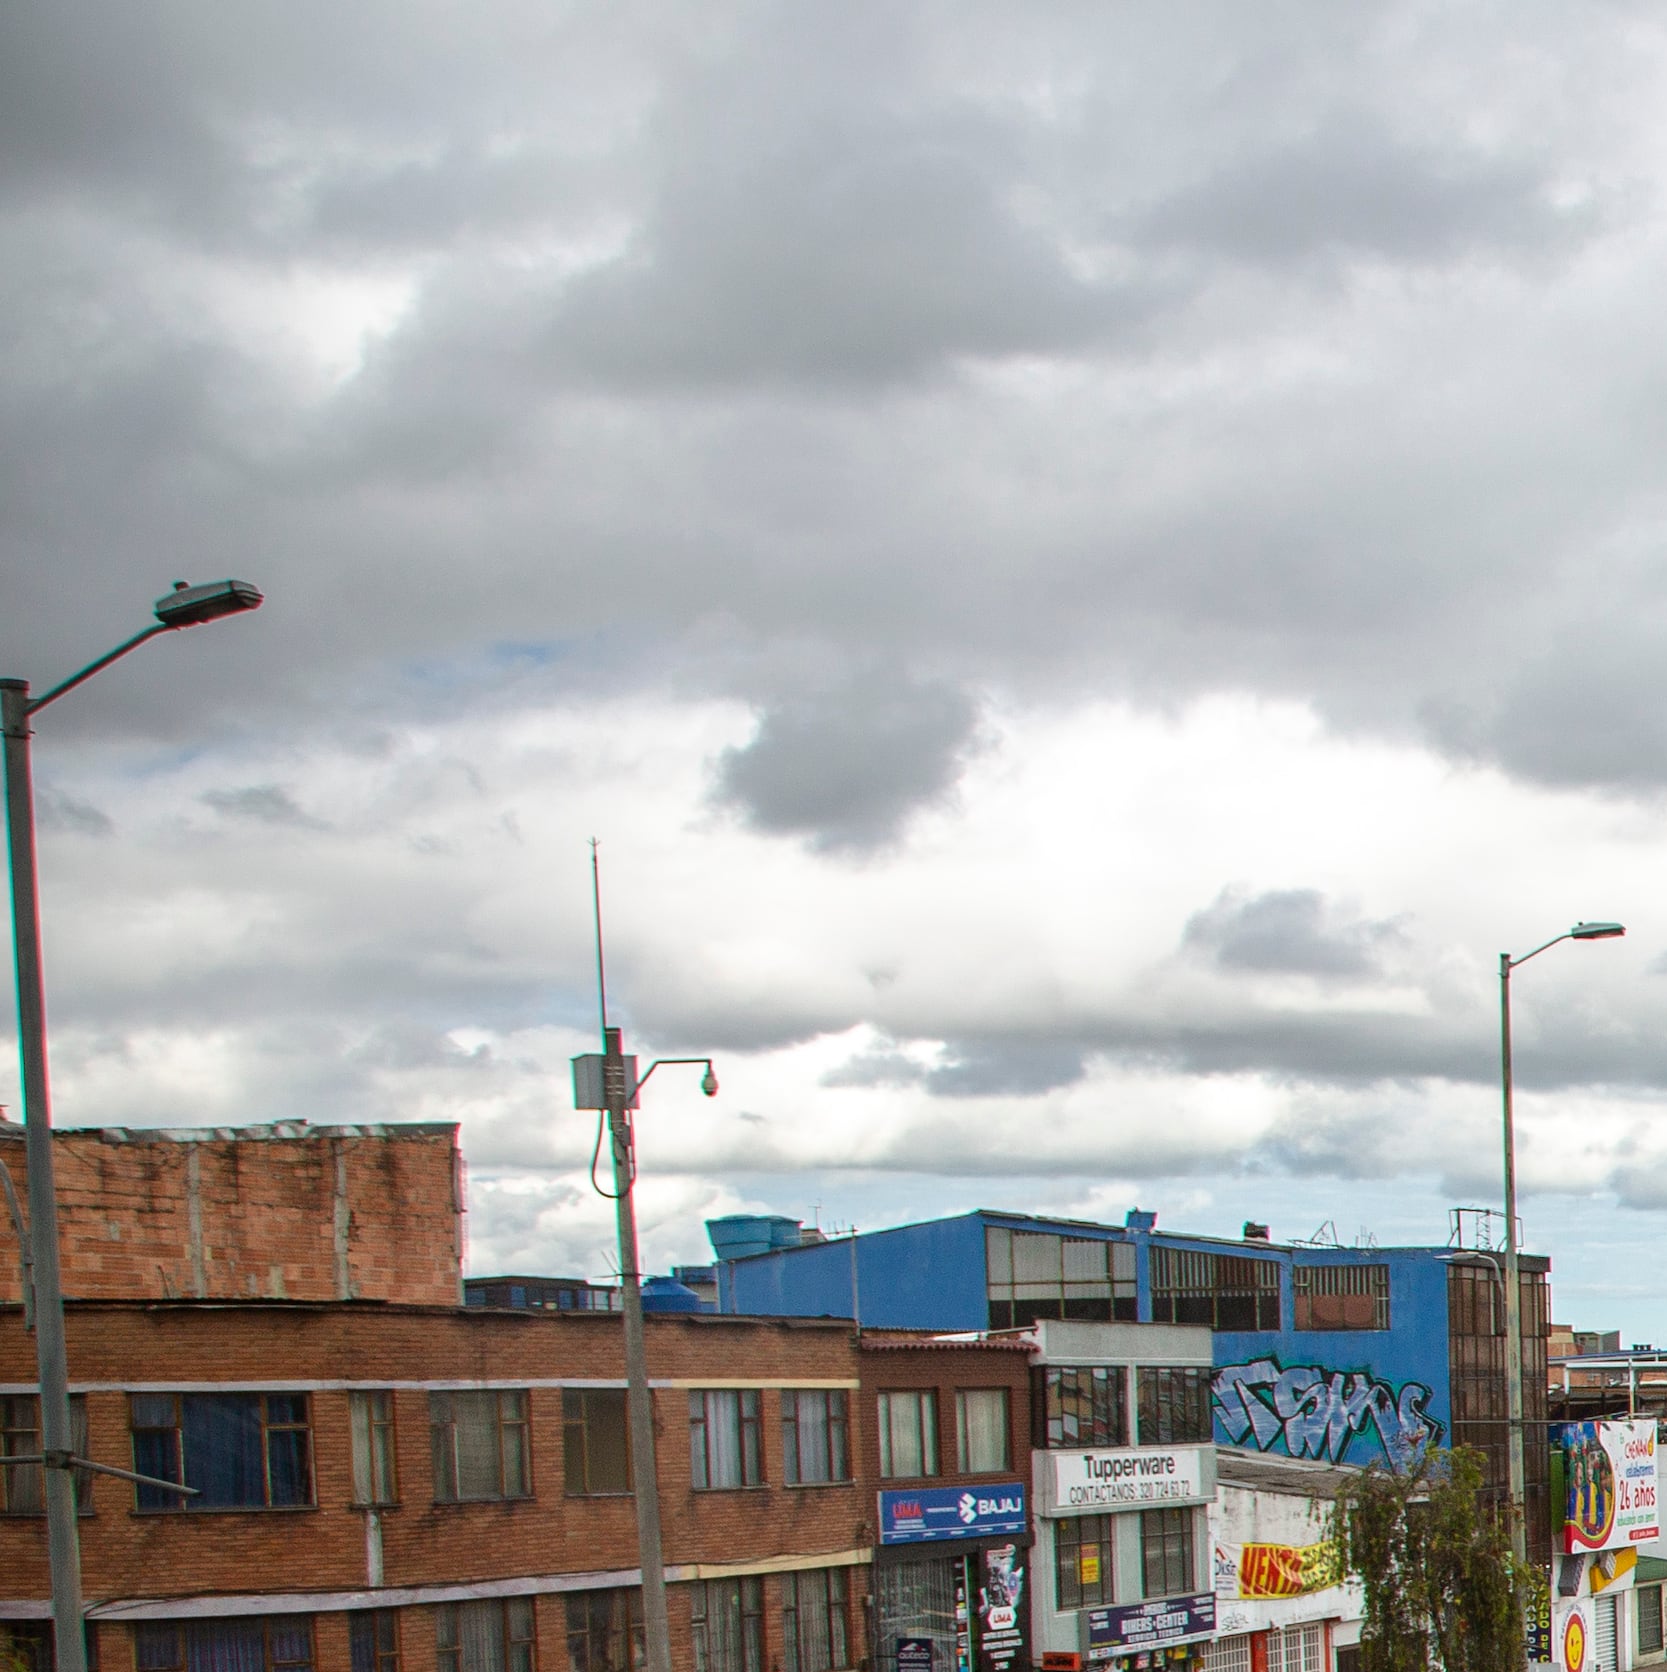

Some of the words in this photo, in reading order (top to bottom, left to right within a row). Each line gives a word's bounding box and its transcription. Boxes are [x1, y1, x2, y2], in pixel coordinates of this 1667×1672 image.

[1083, 1455, 1175, 1482] Tupperware
[978, 1497, 1022, 1515] BAJAJ
[1619, 1480, 1631, 1511] 26
[1634, 1480, 1656, 1508] años
[1241, 1546, 1303, 1596] VENTA
